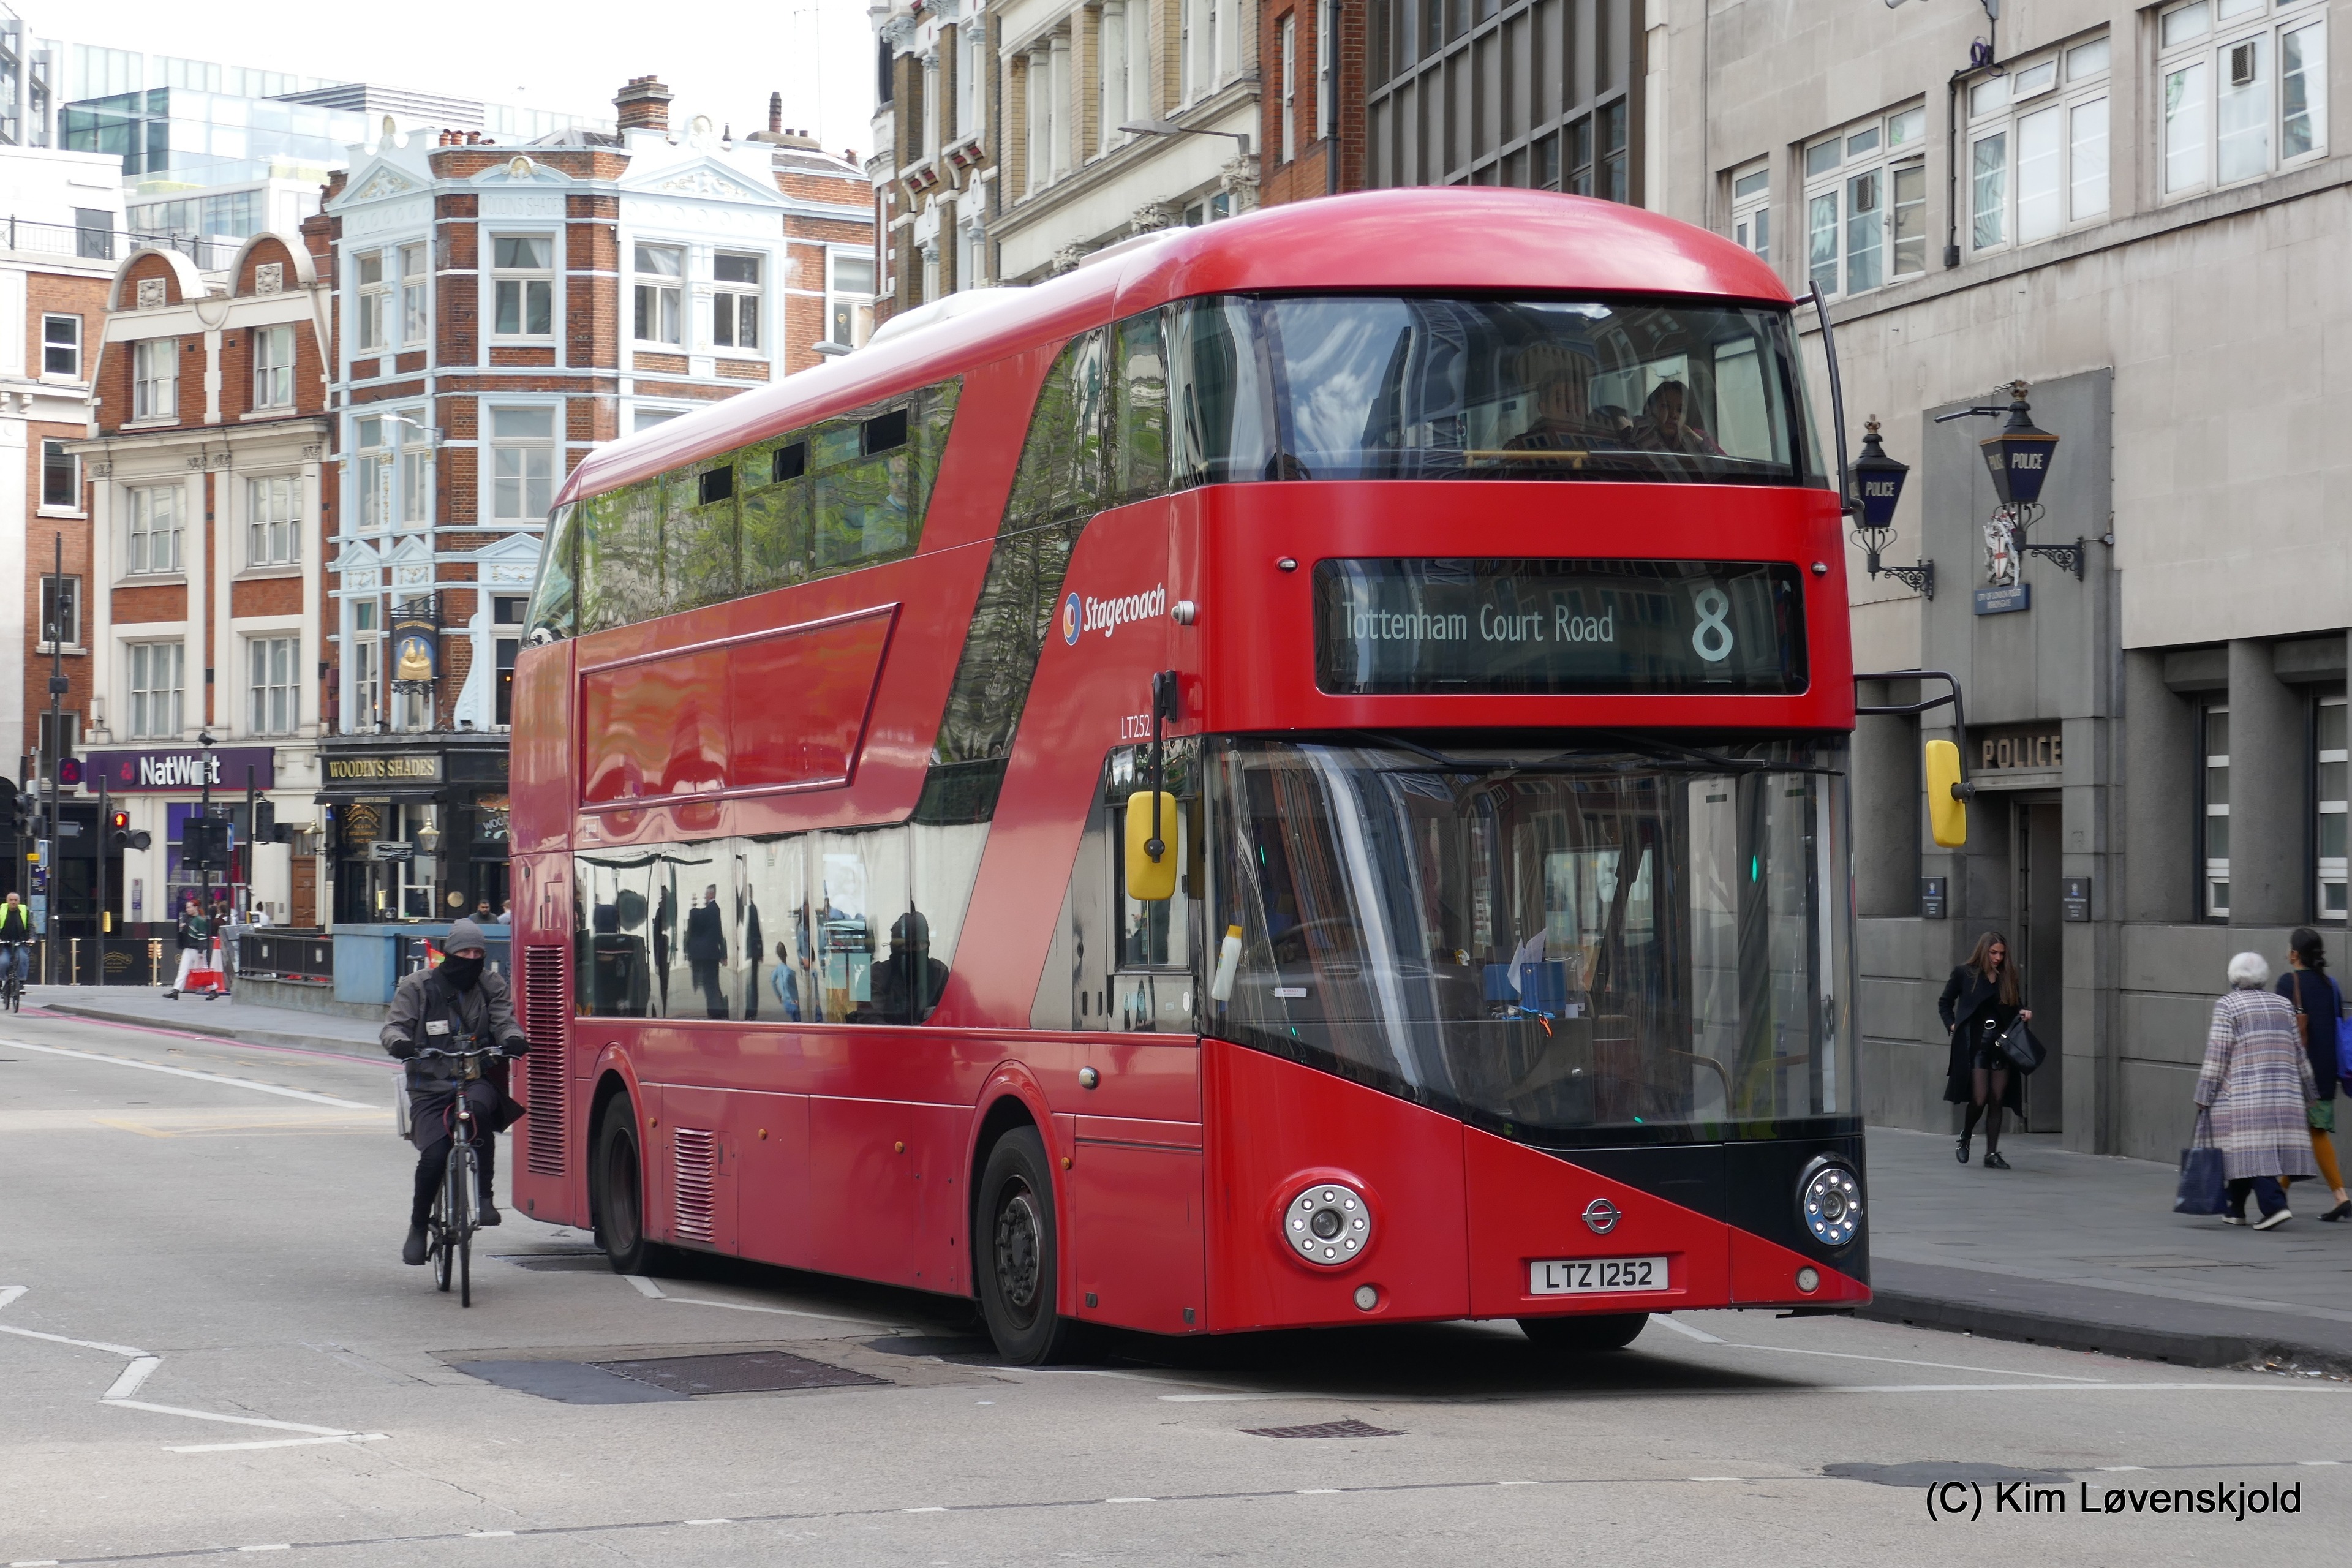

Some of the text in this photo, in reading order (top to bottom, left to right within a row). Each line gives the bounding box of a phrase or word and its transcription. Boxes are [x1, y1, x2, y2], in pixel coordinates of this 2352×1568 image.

[2011, 453, 2043, 469] POLICE
[1865, 481, 1895, 497] POLICE
[1084, 582, 1166, 638] Stagecoach
[1342, 601, 1613, 642] Tottenham Court Road
[1692, 588, 1733, 662] 8
[1121, 714, 1151, 739] LT252
[1983, 735, 2062, 769] POLICE
[140, 755, 221, 785] NatWt
[329, 759, 435, 778] WOODIN'S SHADES
[1546, 1262, 1652, 1289] LTZ 1252
